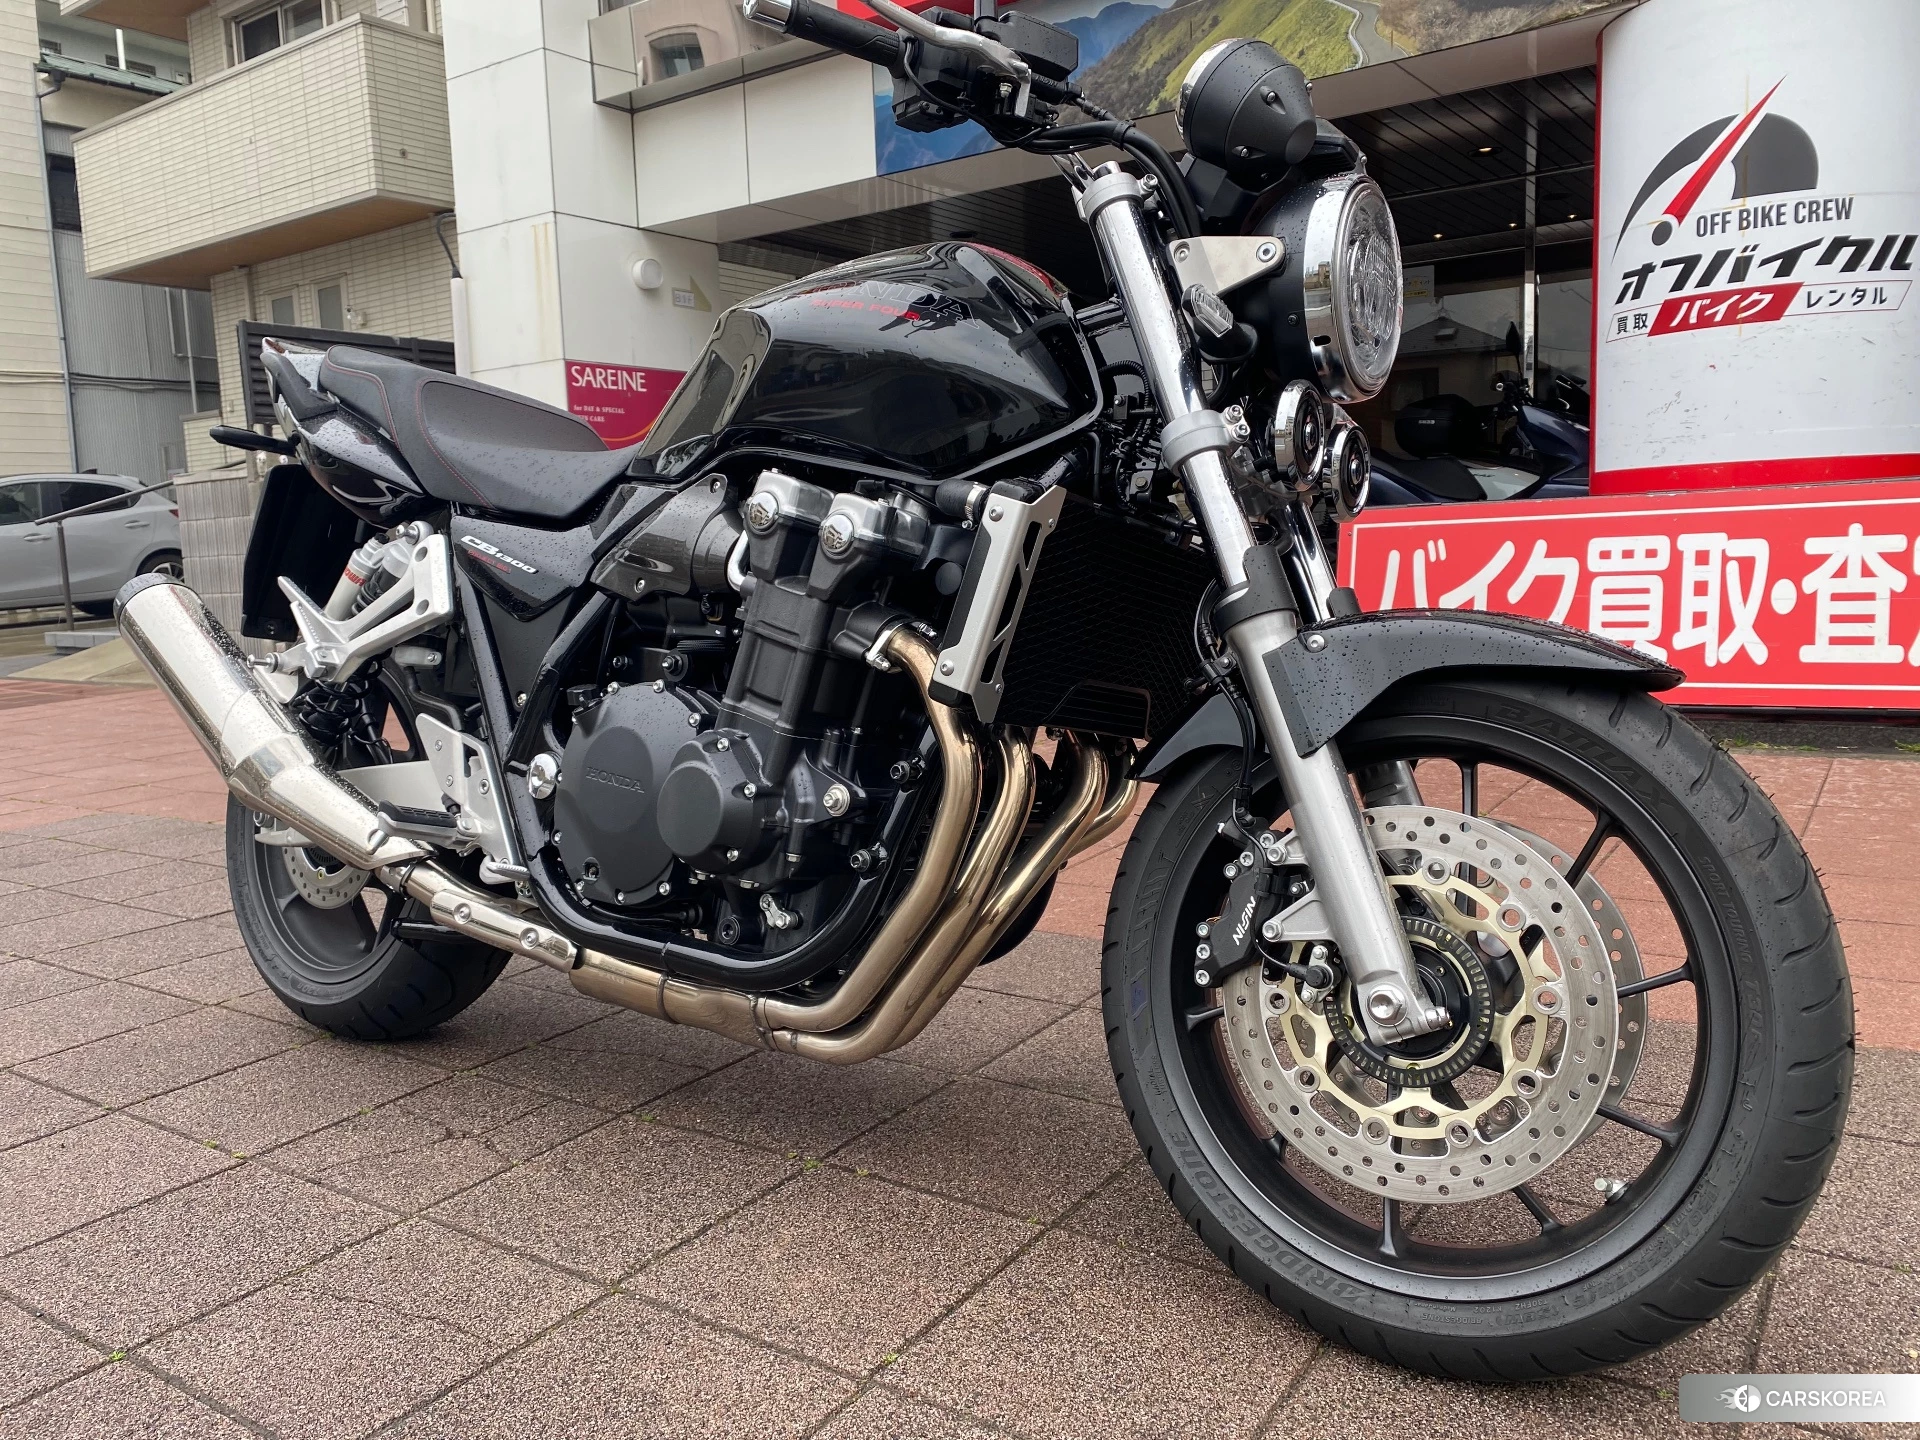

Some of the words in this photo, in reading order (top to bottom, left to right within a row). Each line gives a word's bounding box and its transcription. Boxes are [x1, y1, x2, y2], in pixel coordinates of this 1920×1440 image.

[1695, 212, 1732, 238] OFF
[1738, 202, 1787, 231] BIKE
[1794, 197, 1854, 223] CREW
[1613, 233, 1919, 306] オフバイクル
[868, 303, 921, 321] FOUR
[1615, 312, 1649, 336] 買取
[1669, 291, 1775, 328] バイク
[1806, 286, 1888, 309] レンタル
[570, 365, 647, 392] SAREINE
[460, 535, 537, 574] CB1300
[1380, 522, 1920, 666] バイク買取・査
[585, 766, 645, 793] HONDA
[1232, 896, 1256, 946] NISSIN
[1700, 856, 1730, 898] SPORT
[1722, 901, 1753, 963] TOURING
[1167, 1130, 1367, 1300] BRIDGESTONE
